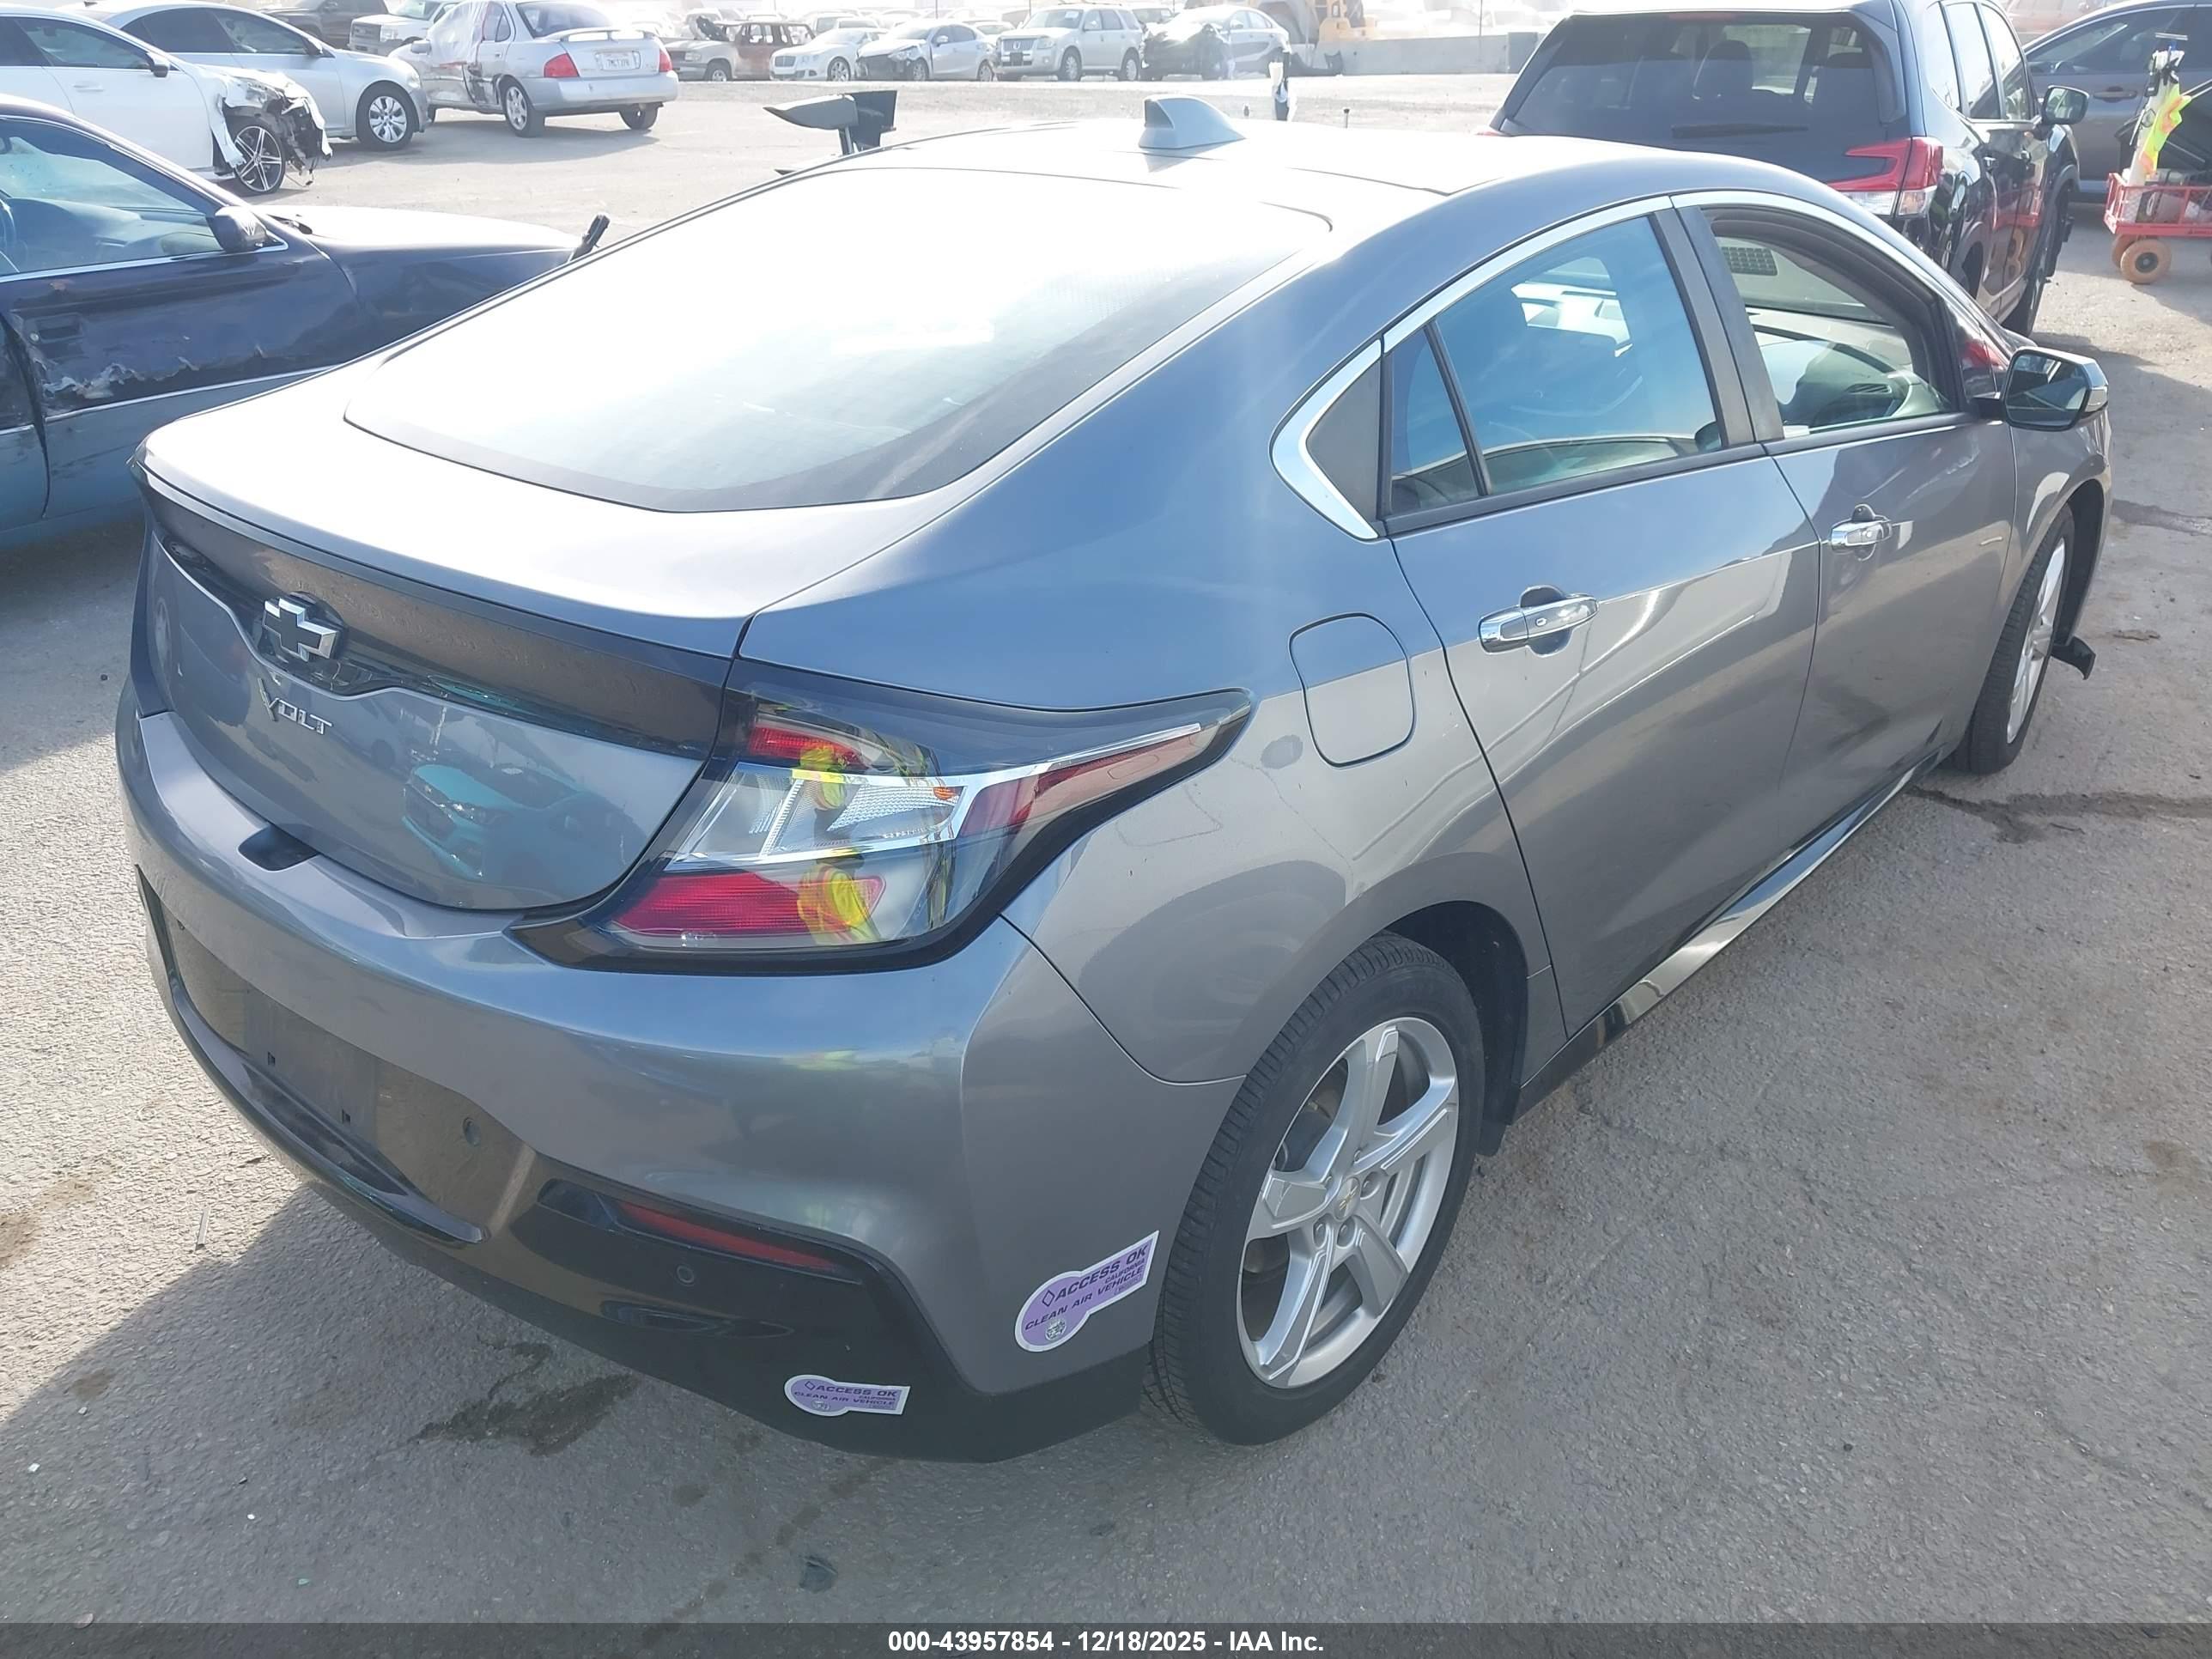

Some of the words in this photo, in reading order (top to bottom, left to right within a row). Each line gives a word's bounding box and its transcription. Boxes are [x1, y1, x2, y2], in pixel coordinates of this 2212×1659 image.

[258, 678, 332, 735] VOLT
[1054, 1261, 1121, 1302] ACCESS
[1126, 1245, 1148, 1265] OK
[1104, 1258, 1146, 1284] CALIFORNIA
[1024, 1305, 1068, 1331] CLEAN
[1071, 1293, 1093, 1310] AIR
[1097, 1266, 1144, 1295] VEHICLE
[794, 1391, 829, 1400] CLEAN
[817, 1385, 872, 1395] ACCESS
